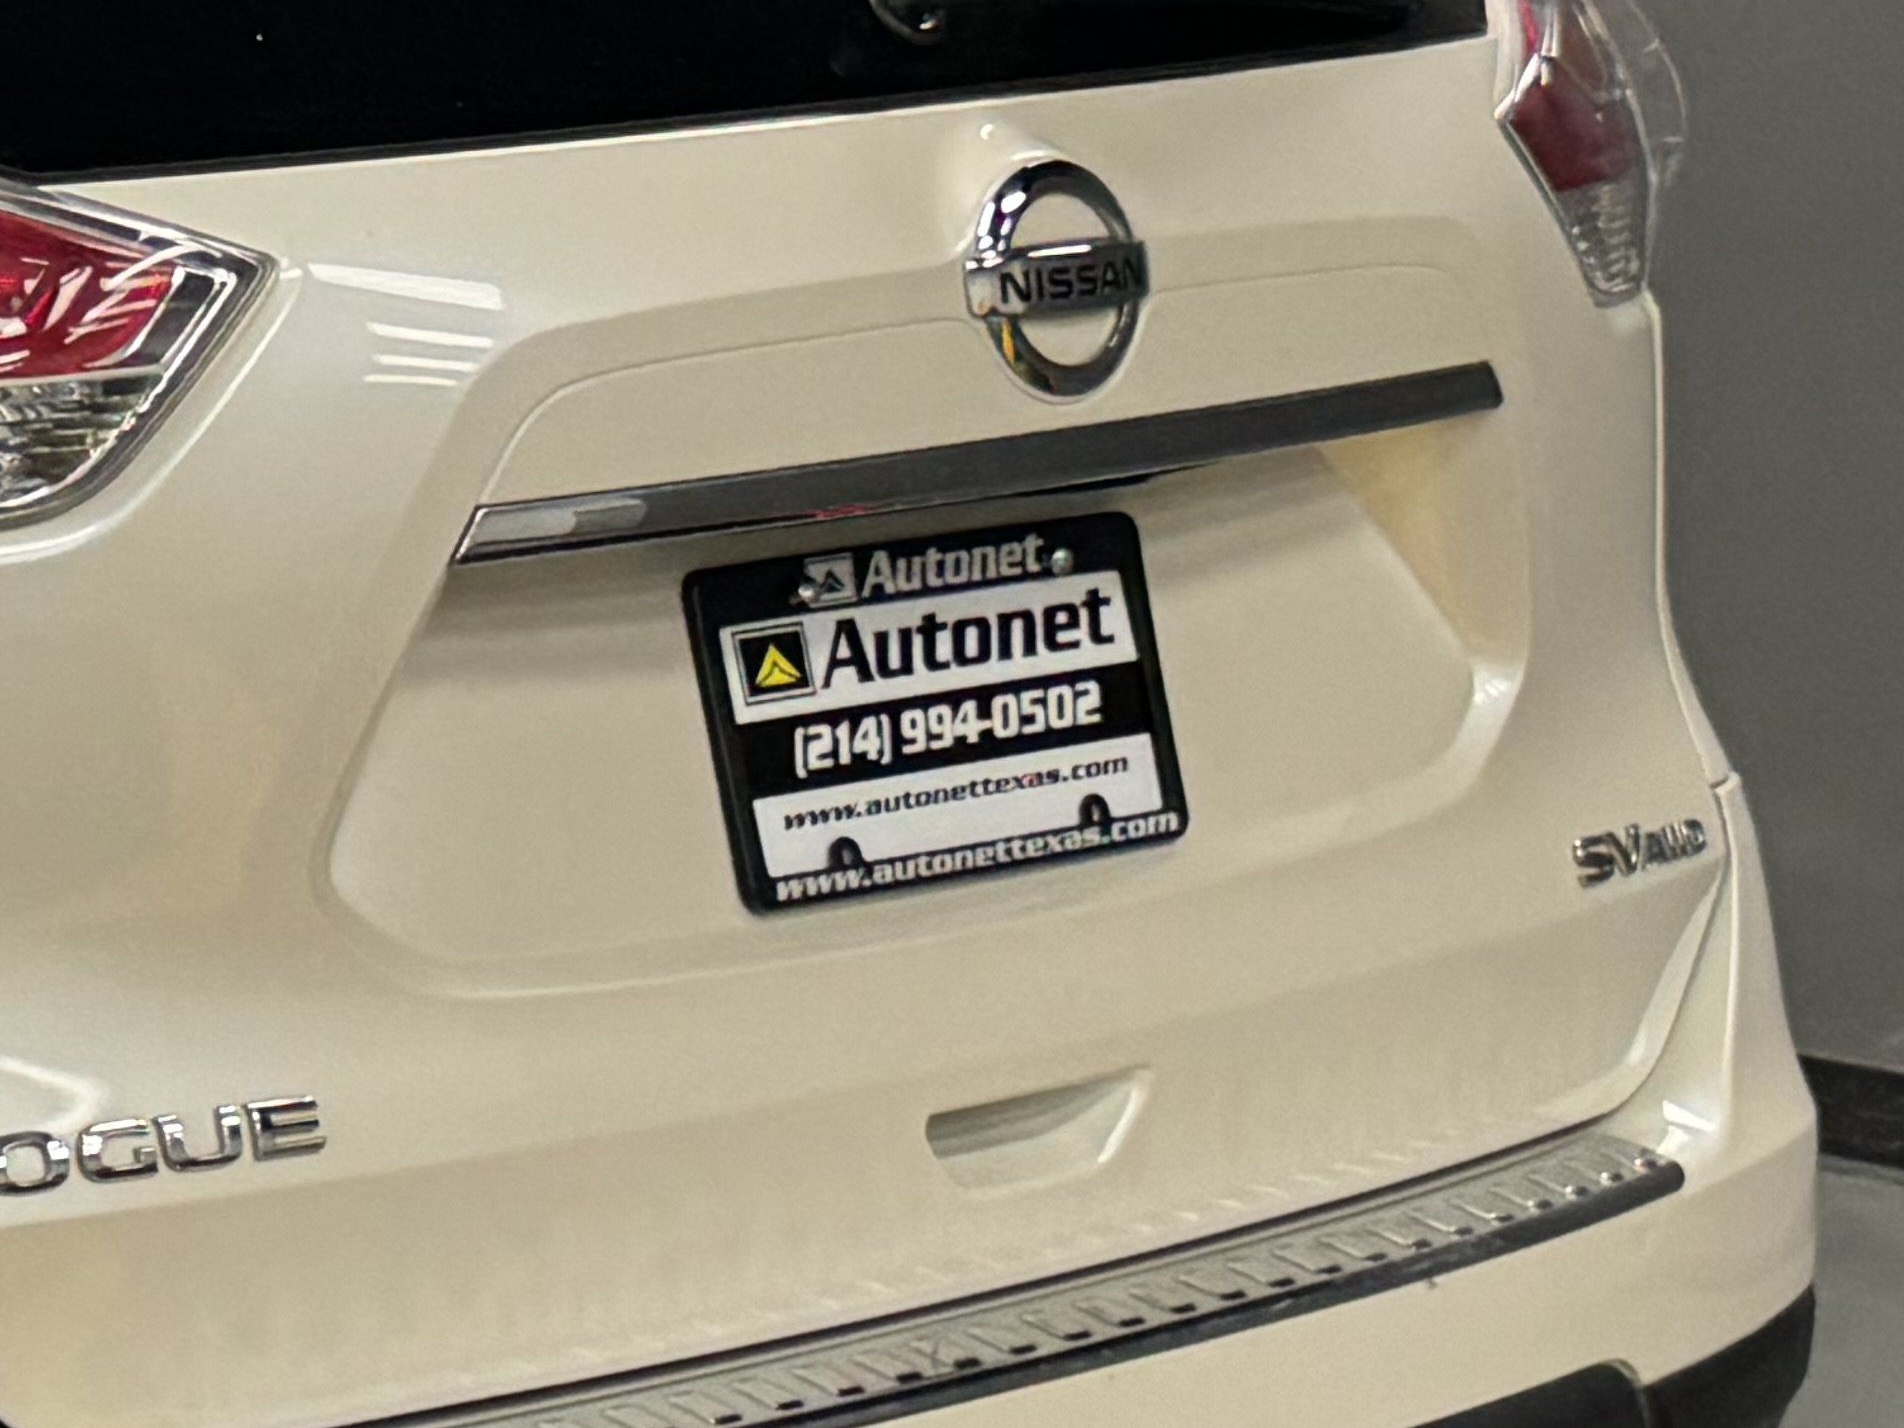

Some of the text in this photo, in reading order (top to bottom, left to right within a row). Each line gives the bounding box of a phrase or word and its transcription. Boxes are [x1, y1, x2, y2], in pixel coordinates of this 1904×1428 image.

[999, 257, 1142, 304] NISSAN
[861, 532, 1044, 600] Autonet
[820, 587, 1115, 690] Autonet
[793, 679, 1104, 778] (214) 994-0502
[783, 752, 1130, 831] www.autonettexas.com
[776, 807, 1180, 902] www.autonettexas.com
[1572, 823, 1641, 890] SV
